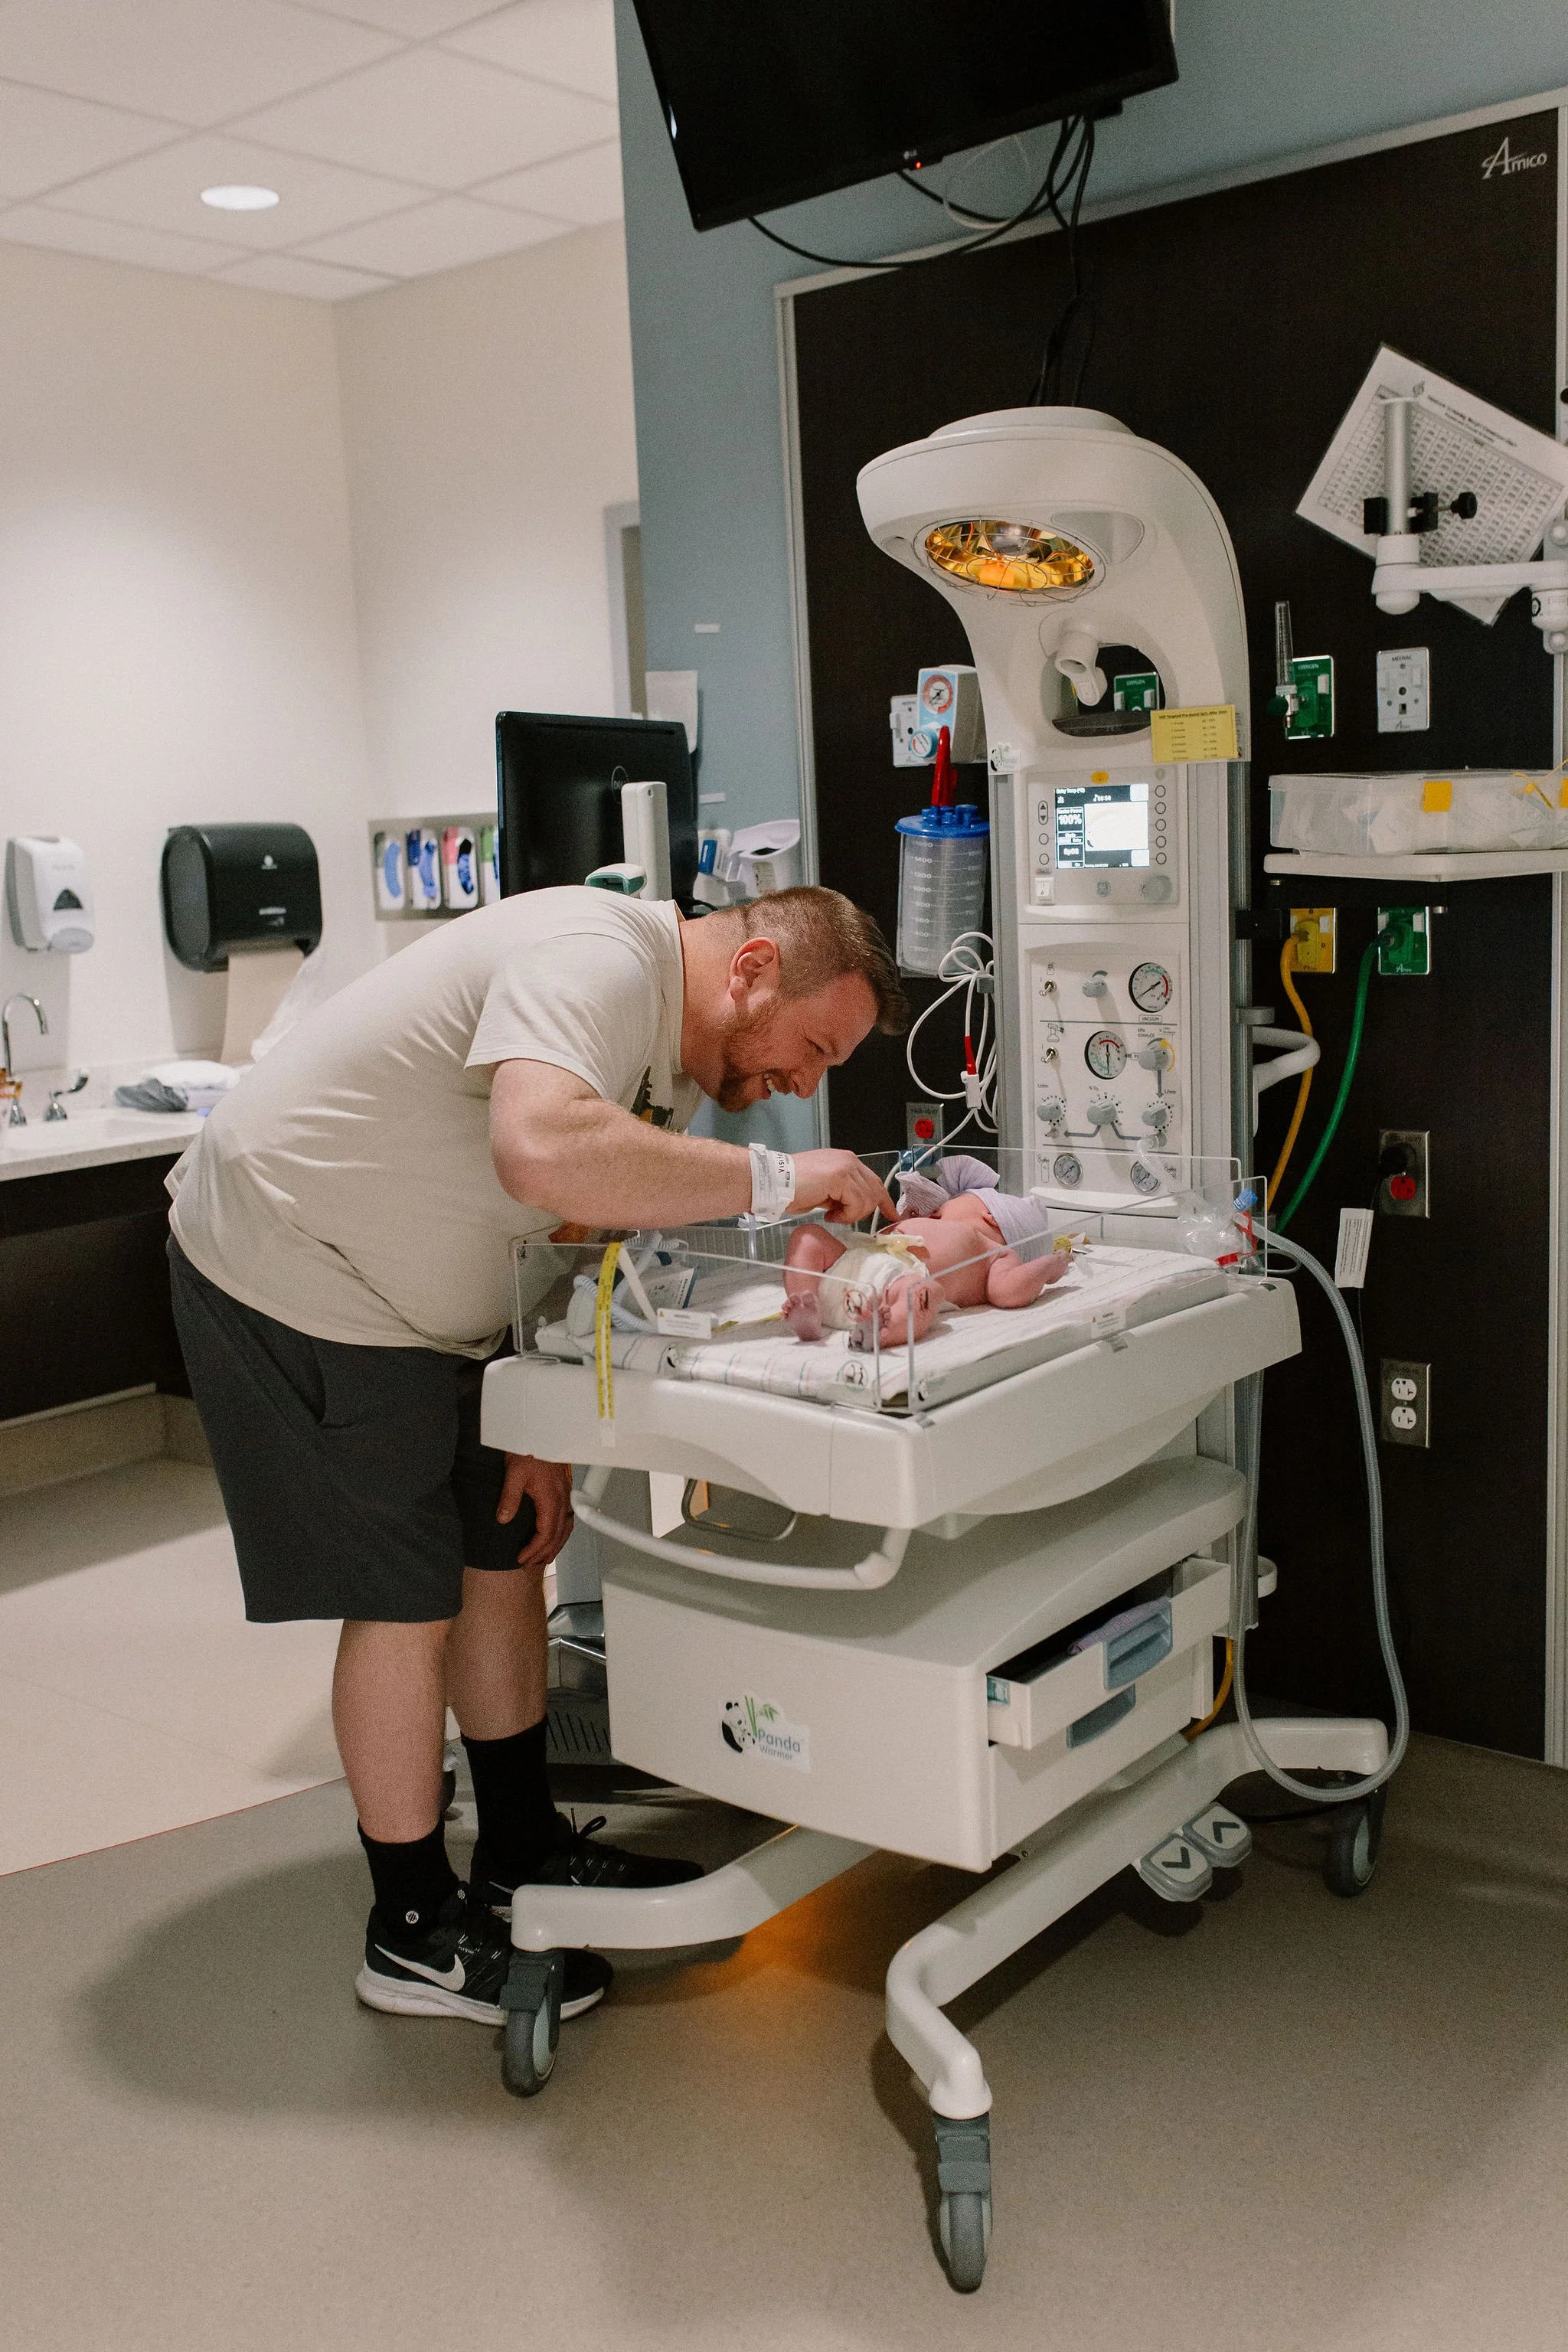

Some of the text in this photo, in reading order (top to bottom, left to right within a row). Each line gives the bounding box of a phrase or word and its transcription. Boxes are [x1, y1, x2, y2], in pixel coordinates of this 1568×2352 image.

[1481, 136, 1547, 180] Amico
[1058, 814, 1082, 825] 100%
[757, 1727, 801, 1753] Panda
[759, 1745, 792, 1760] Warmer
